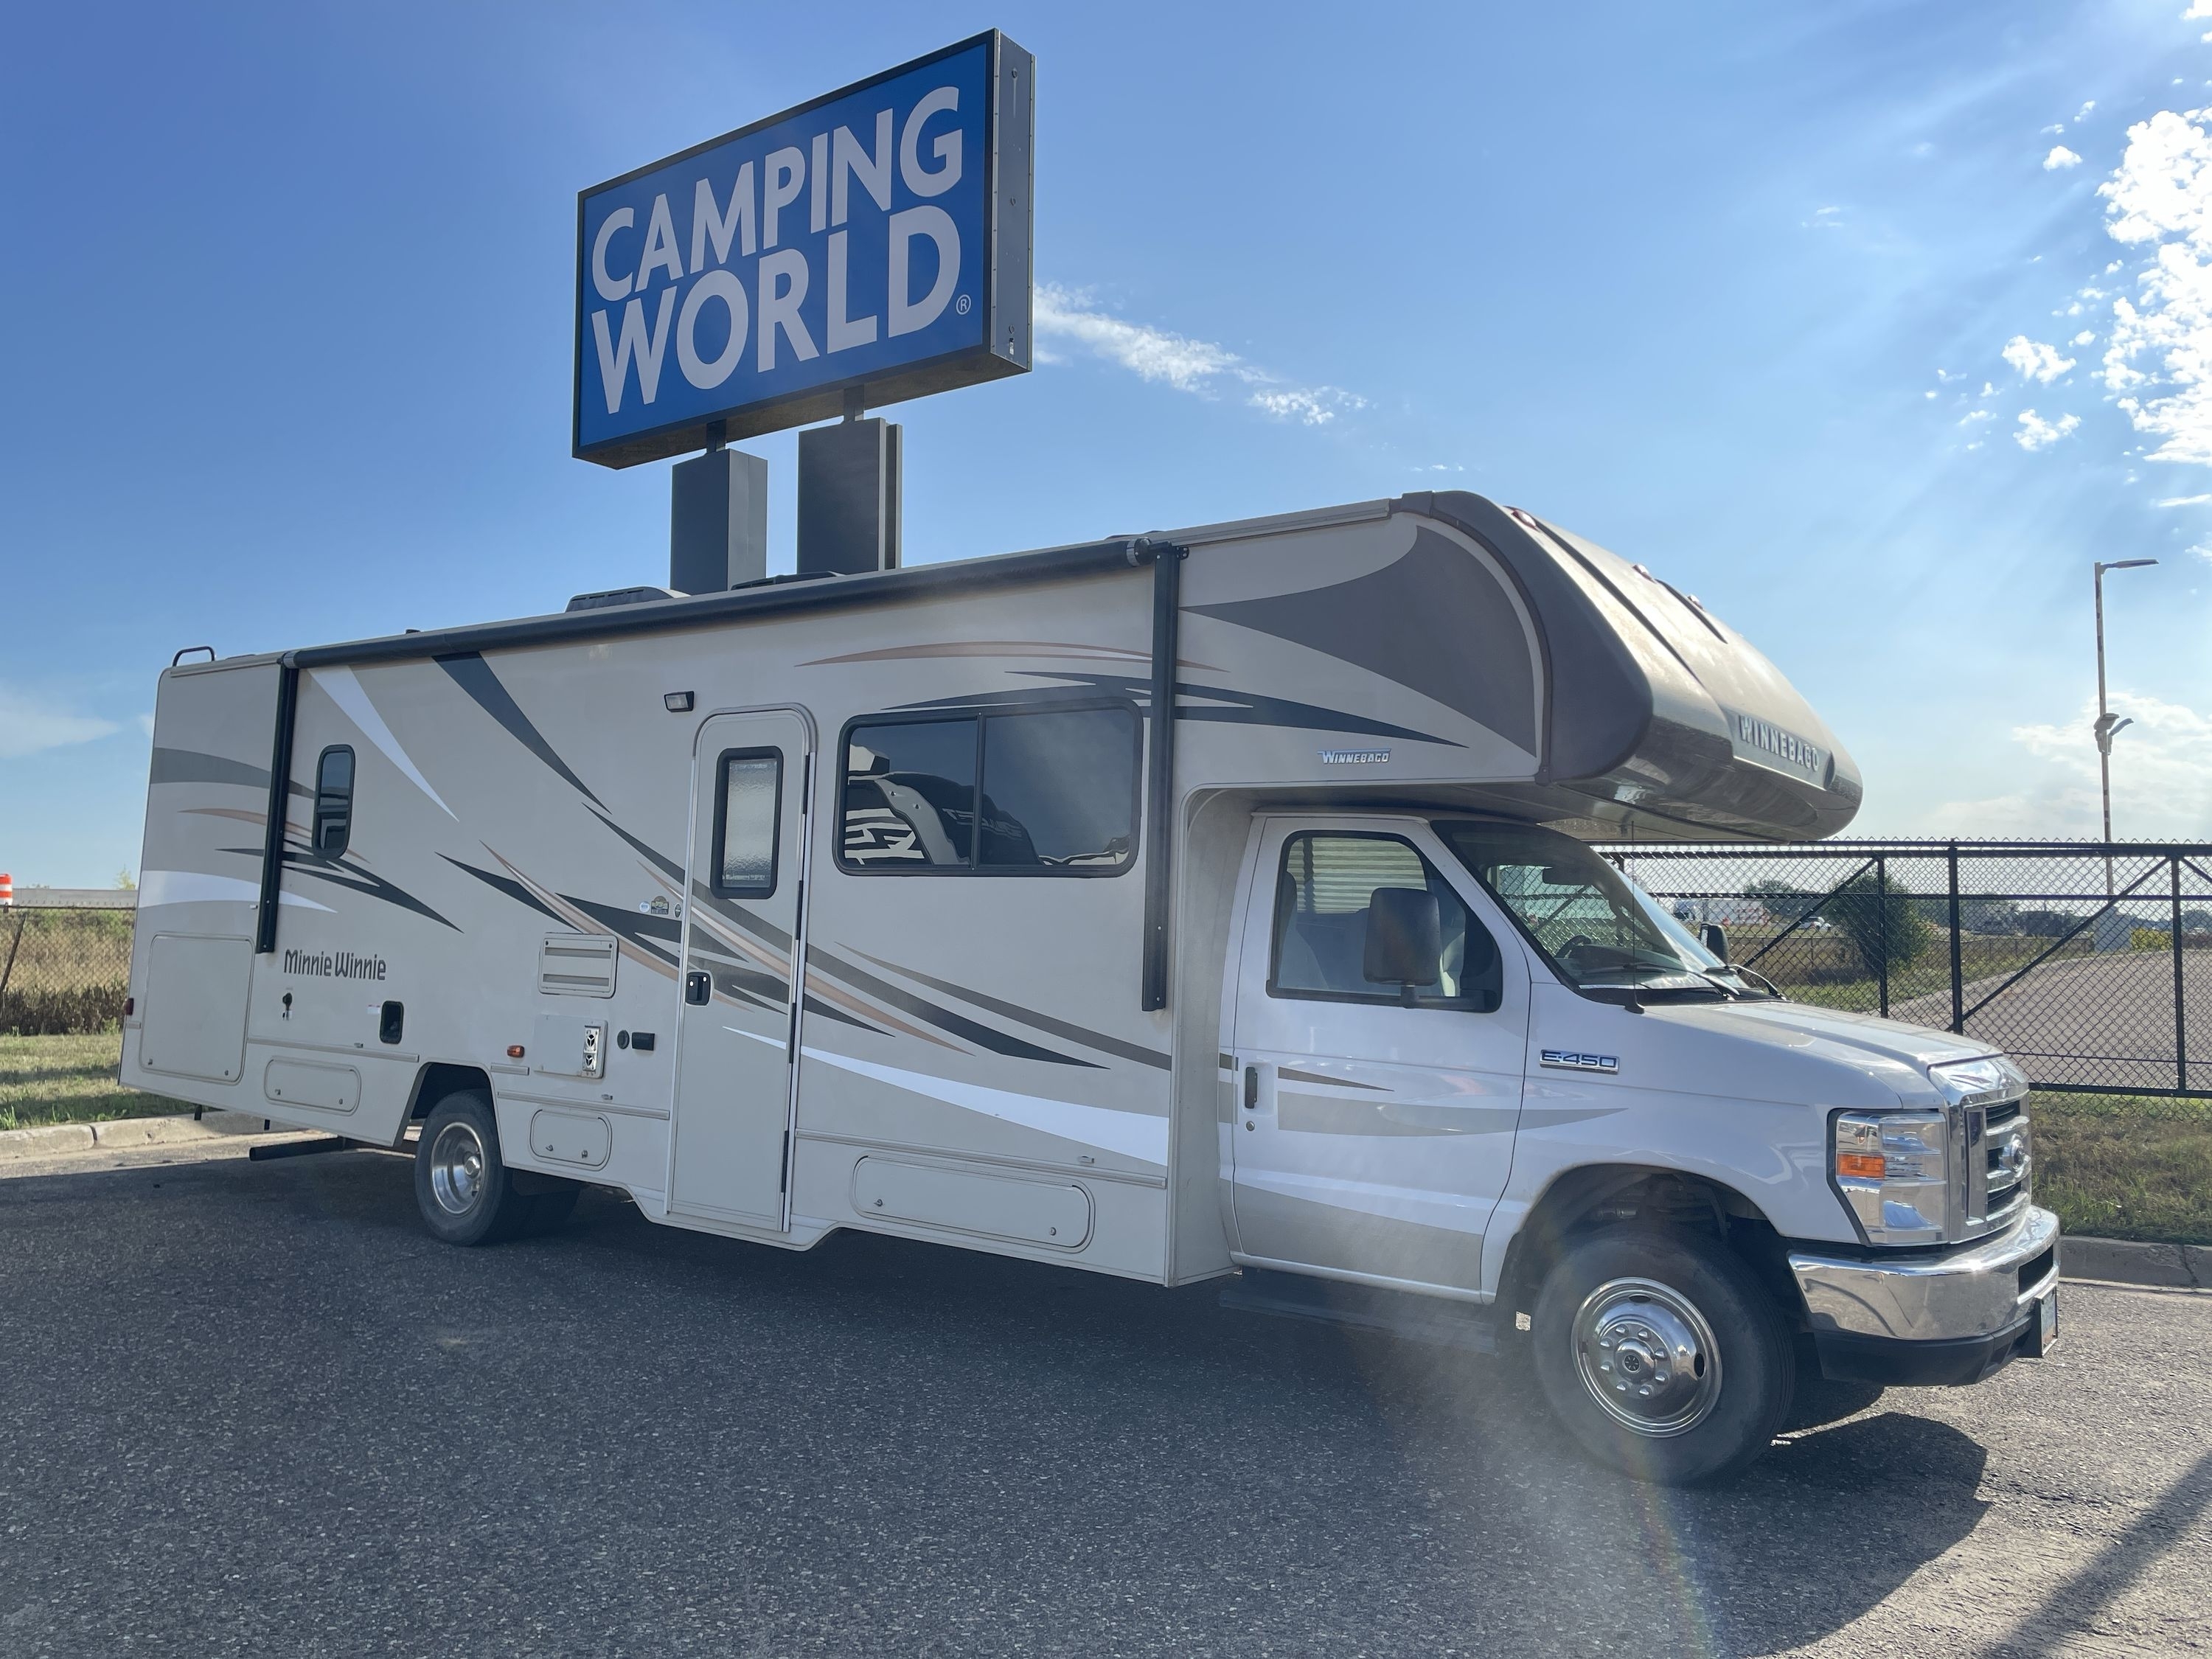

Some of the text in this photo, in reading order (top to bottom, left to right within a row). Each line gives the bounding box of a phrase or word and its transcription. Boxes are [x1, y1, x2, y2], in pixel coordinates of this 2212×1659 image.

[592, 86, 962, 302] CAMPING
[591, 205, 961, 414] WORLD
[1317, 749, 1392, 764] WINNEBAGO
[1739, 714, 1819, 771] WINNEBAGO
[283, 949, 386, 981] Minnie Winnie
[1541, 1051, 1617, 1068] E-450
